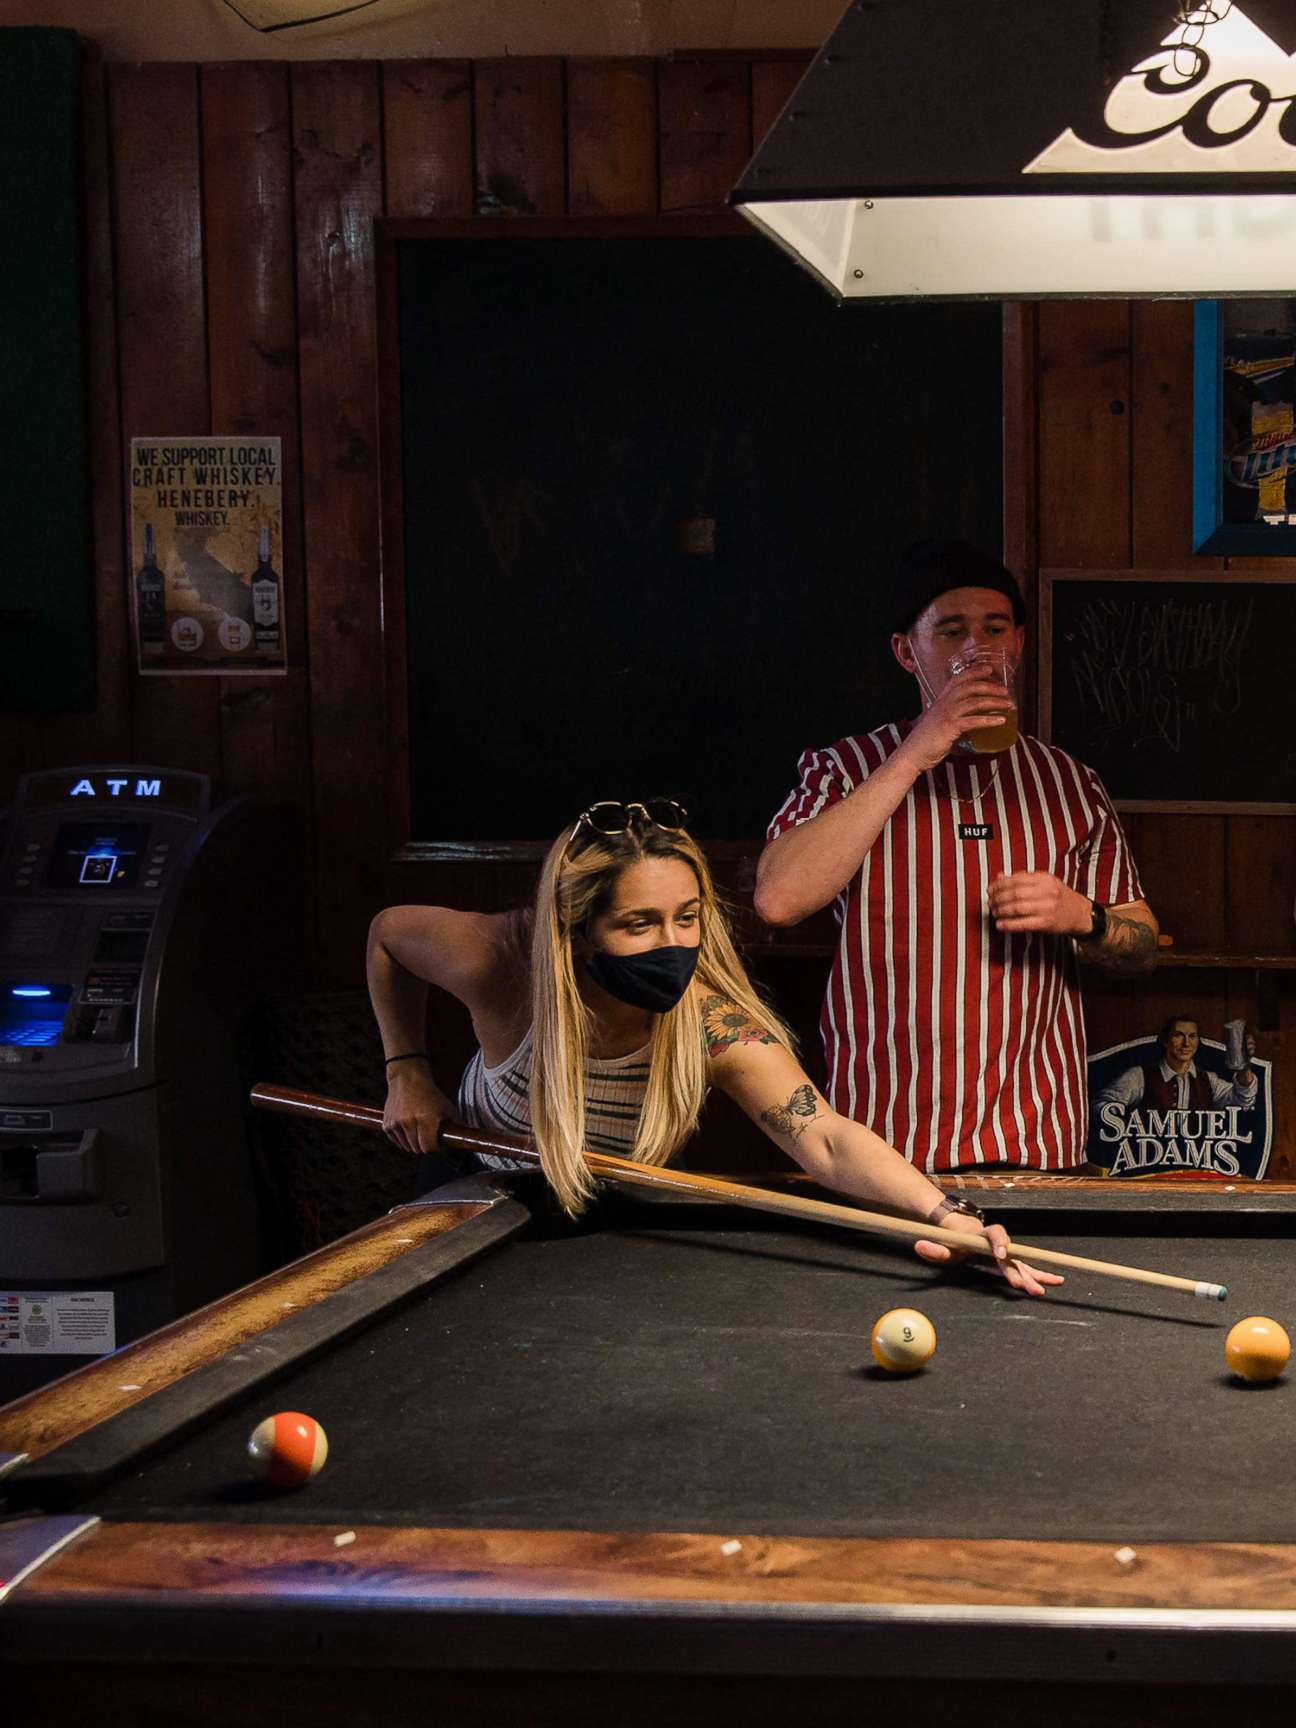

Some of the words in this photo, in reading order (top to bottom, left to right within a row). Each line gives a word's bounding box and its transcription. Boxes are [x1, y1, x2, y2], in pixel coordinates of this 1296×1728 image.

[137, 447, 158, 466] WE
[162, 447, 225, 466] SUPPORT
[230, 447, 276, 466] LOCAL
[132, 467, 186, 486] CRAFT
[69, 779, 161, 797] ATM
[963, 827, 988, 837] HUF
[1099, 1102, 1253, 1143] SAMUEL
[1109, 1138, 1239, 1176] ADAMS
